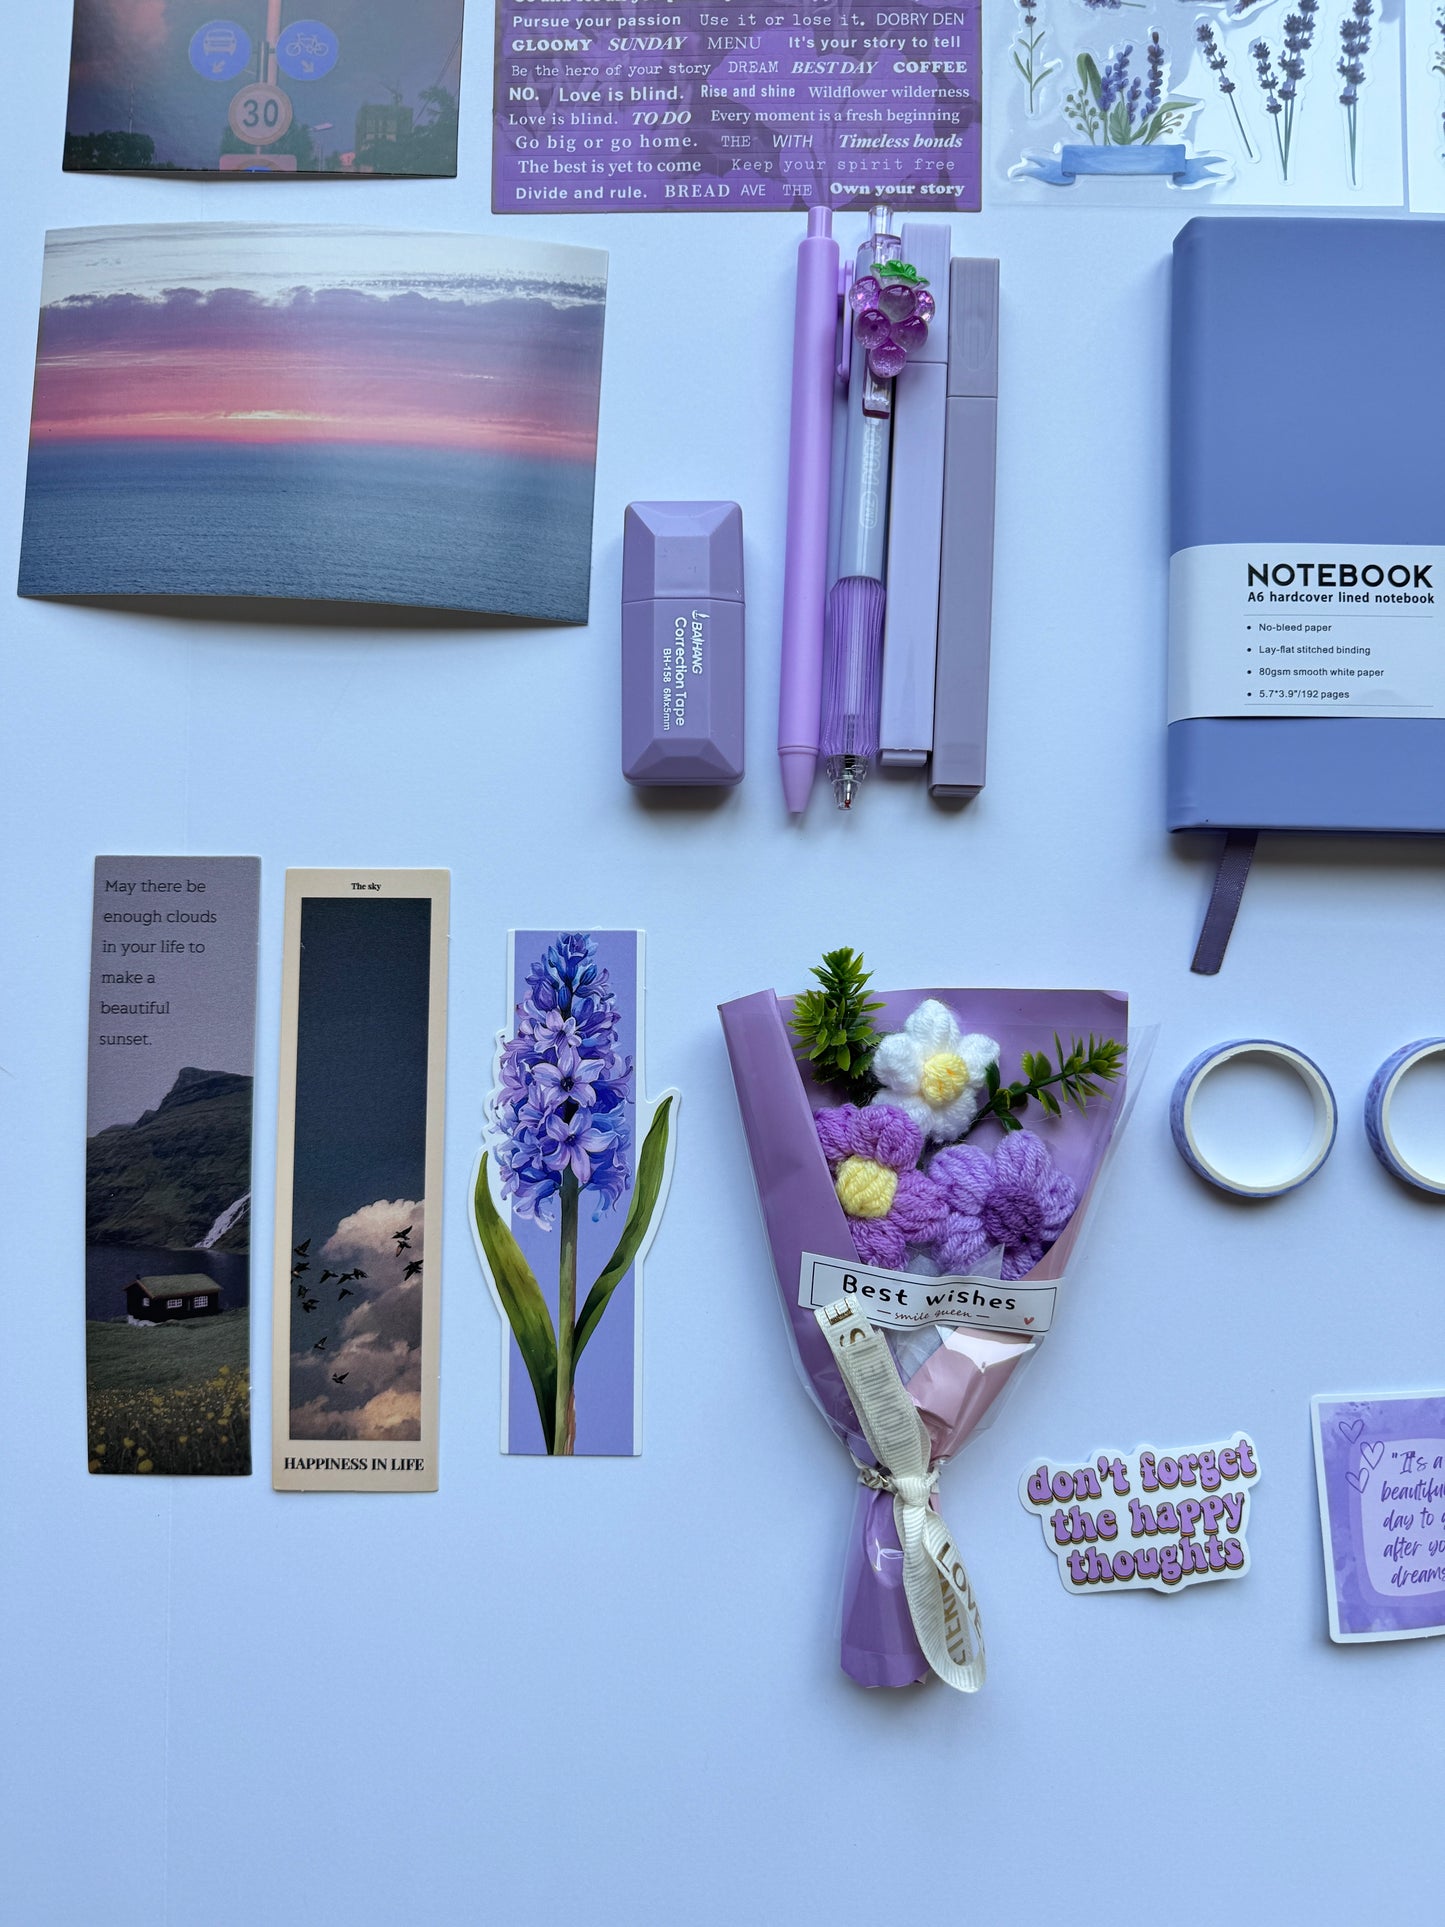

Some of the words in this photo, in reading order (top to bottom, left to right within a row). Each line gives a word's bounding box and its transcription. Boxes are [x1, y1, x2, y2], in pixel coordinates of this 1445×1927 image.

[513, 16, 569, 27] Pursue
[575, 18, 611, 30] your
[618, 14, 681, 28] passion
[700, 14, 728, 25] Use
[738, 15, 756, 26] it
[765, 16, 784, 26] or
[793, 14, 832, 26] lose
[841, 15, 865, 26] it.
[877, 13, 928, 25] DOBRY
[934, 13, 964, 25] DEN
[512, 39, 592, 51] GLOOMY
[608, 37, 687, 50] SUNDAY
[707, 37, 761, 49] MENU
[789, 37, 814, 48] It's
[821, 38, 857, 50] your
[863, 38, 906, 50] story
[912, 38, 927, 48] to
[934, 36, 960, 47] tell
[511, 66, 528, 76] Be
[536, 66, 559, 76] the
[565, 66, 599, 76] hero
[606, 65, 622, 76] of
[628, 67, 662, 77] your
[669, 65, 711, 76] story
[728, 61, 779, 73] DREAM
[893, 62, 967, 73] COFFEE
[509, 88, 539, 100] NO.
[559, 88, 601, 102] Love
[609, 89, 623, 101] is
[631, 86, 684, 100] blind.
[701, 85, 727, 98] Rise
[733, 85, 755, 97] and
[761, 85, 795, 97] shine
[809, 86, 888, 98] Wildflower
[891, 86, 970, 97] wilderness
[242, 99, 279, 128] 30
[509, 114, 545, 125] Love
[552, 115, 564, 125] is
[571, 114, 618, 125] blind.
[632, 112, 659, 125] TO
[661, 111, 691, 124] DO
[711, 110, 750, 124] Every
[755, 112, 815, 121] moment
[819, 110, 830, 121] is
[834, 113, 842, 121] a
[847, 109, 882, 121] fresh
[887, 110, 960, 123] beginning
[516, 137, 539, 149] Go
[548, 136, 576, 152] big
[584, 139, 603, 148] or
[611, 139, 632, 152] go
[640, 135, 698, 148] home.
[721, 136, 750, 147] THE
[773, 135, 813, 148] WITH
[839, 135, 909, 148] Timeless
[913, 134, 962, 147] bonds
[519, 160, 548, 173] The
[554, 160, 587, 173] best
[592, 160, 604, 173] is
[609, 162, 632, 176] yet
[637, 162, 652, 173] to
[657, 162, 701, 172] come
[732, 159, 773, 172] Keep
[784, 161, 825, 172] your
[837, 159, 903, 172] spirit
[914, 159, 954, 170] free
[516, 187, 567, 199] Divide
[574, 187, 603, 199] and
[610, 186, 647, 198] rule.
[665, 185, 730, 197] BREAD
[741, 184, 766, 196] AVE
[783, 184, 812, 196] THE
[830, 183, 871, 194] Own
[876, 184, 915, 196] your
[921, 183, 965, 196] story
[1247, 563, 1433, 588] NOTEBOOK
[1248, 592, 1264, 602] A6
[1270, 592, 1333, 602] hardcover
[1338, 592, 1369, 603] lined
[1375, 592, 1434, 604] notebook
[1259, 624, 1302, 632] No-bleed
[1305, 625, 1332, 633] paper
[675, 617, 687, 688] Correction
[691, 621, 704, 674] BAIHANG
[1259, 646, 1295, 655] Lay-flat
[1297, 646, 1334, 654] stitched
[1336, 646, 1370, 656] binding
[663, 648, 671, 682] BH-158
[1259, 668, 1290, 677] 80gsm
[1293, 668, 1328, 676] smooth
[1330, 668, 1355, 676] white
[1358, 669, 1384, 677] paper
[1321, 691, 1349, 699] pages
[663, 688, 671, 730] 6Mx5mm
[673, 692, 686, 726] Tape
[105, 880, 136, 895] May
[141, 880, 182, 892] there
[187, 880, 206, 892] be
[368, 883, 381, 891] sky
[103, 910, 162, 926] enough
[166, 910, 217, 923] clouds
[102, 940, 116, 953] in
[121, 943, 156, 956] your
[160, 940, 185, 953] life
[190, 942, 205, 953] to
[102, 971, 143, 984] make
[147, 974, 155, 983] a
[101, 1001, 169, 1014] beautiful
[100, 1034, 152, 1046] sunset.
[842, 1274, 908, 1305] Best
[925, 1290, 1016, 1310] wishes
[895, 1312, 929, 1320] smile
[284, 1457, 368, 1470] HAPPINESS
[372, 1458, 387, 1470] IN
[391, 1458, 424, 1471] LIFE
[1433, 1456, 1443, 1469] a
[1027, 1456, 1130, 1505] don't
[1140, 1439, 1257, 1492] forget
[1050, 1505, 1118, 1545] the
[1128, 1492, 1245, 1537] happy
[1383, 1509, 1414, 1531] day
[1420, 1507, 1434, 1528] to
[1384, 1536, 1422, 1562] after
[1067, 1535, 1244, 1585] thoughts
